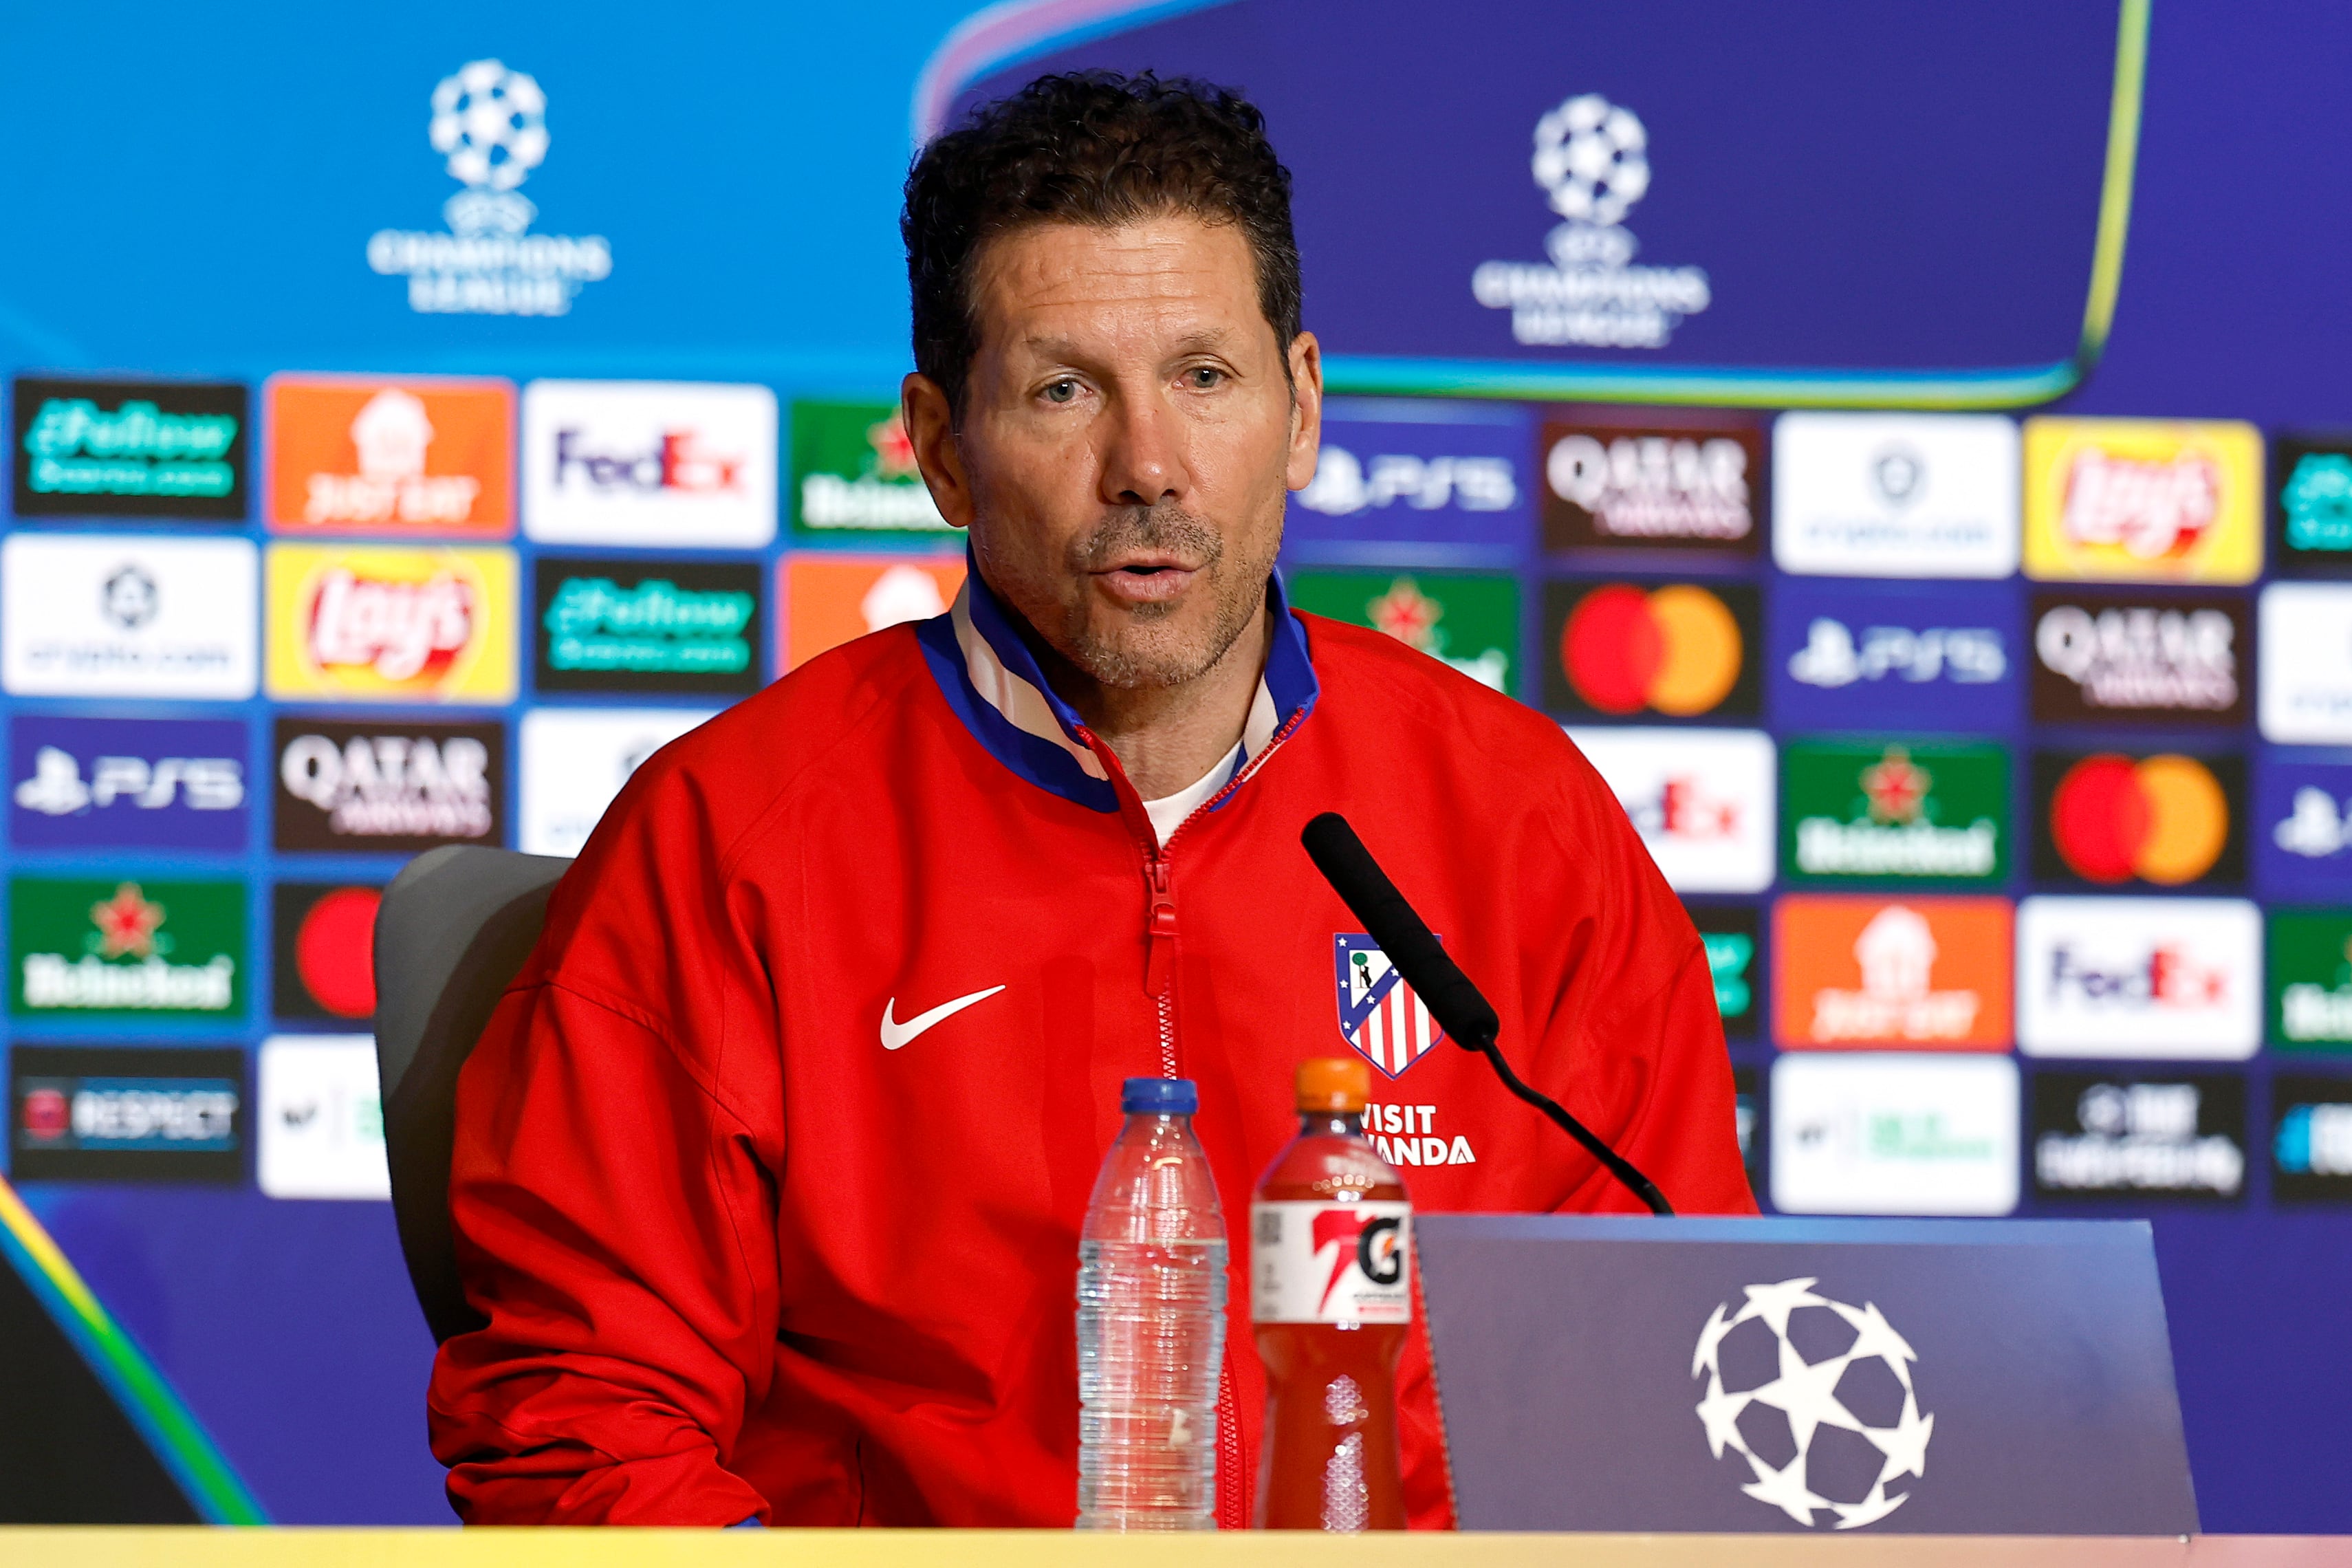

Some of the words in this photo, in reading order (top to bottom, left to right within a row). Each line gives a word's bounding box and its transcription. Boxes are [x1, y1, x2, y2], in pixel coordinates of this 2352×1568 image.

[556, 426, 741, 490] FedEx
[315, 574, 470, 678] Lay's
[93, 758, 243, 809] PS5
[281, 735, 487, 807] QATAR
[2049, 941, 2228, 1007] FedEx
[73, 1092, 236, 1139] RESPECT
[1360, 1103, 1437, 1134] VISIT
[1361, 1133, 1477, 1166] ANDA
[1358, 1217, 1402, 1285] G
